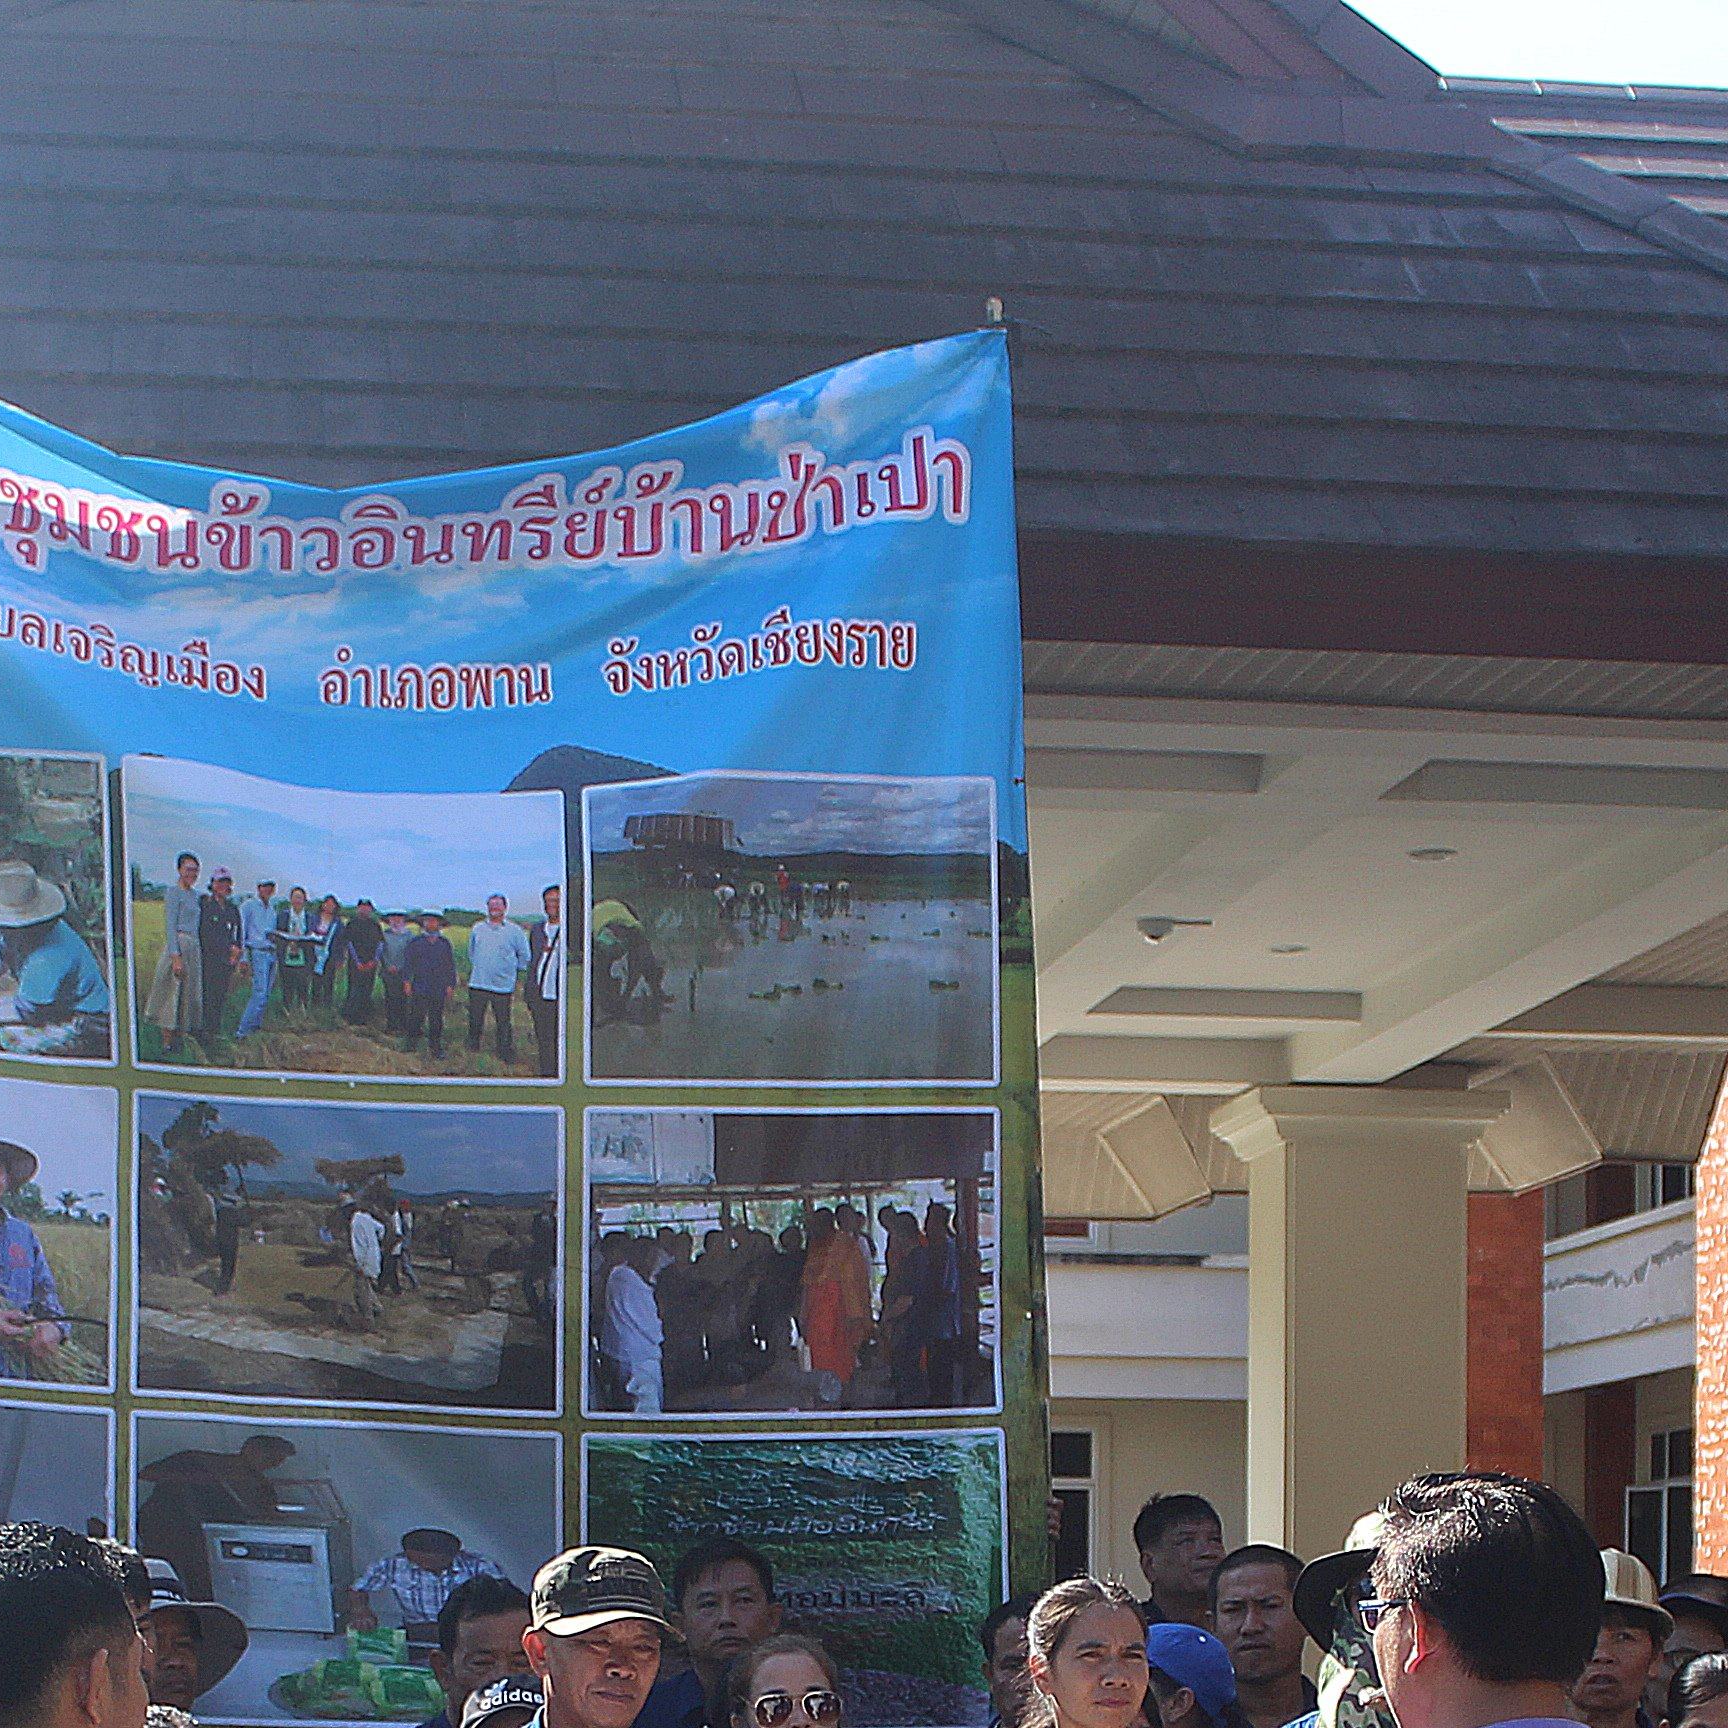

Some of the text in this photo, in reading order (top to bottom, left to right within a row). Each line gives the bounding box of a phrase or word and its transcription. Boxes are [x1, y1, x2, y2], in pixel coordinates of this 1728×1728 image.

[319, 646, 552, 711] อำเภอพาน
[601, 606, 916, 695] จังหวัดเชียงราย
[479, 1687, 544, 1711] adidas
